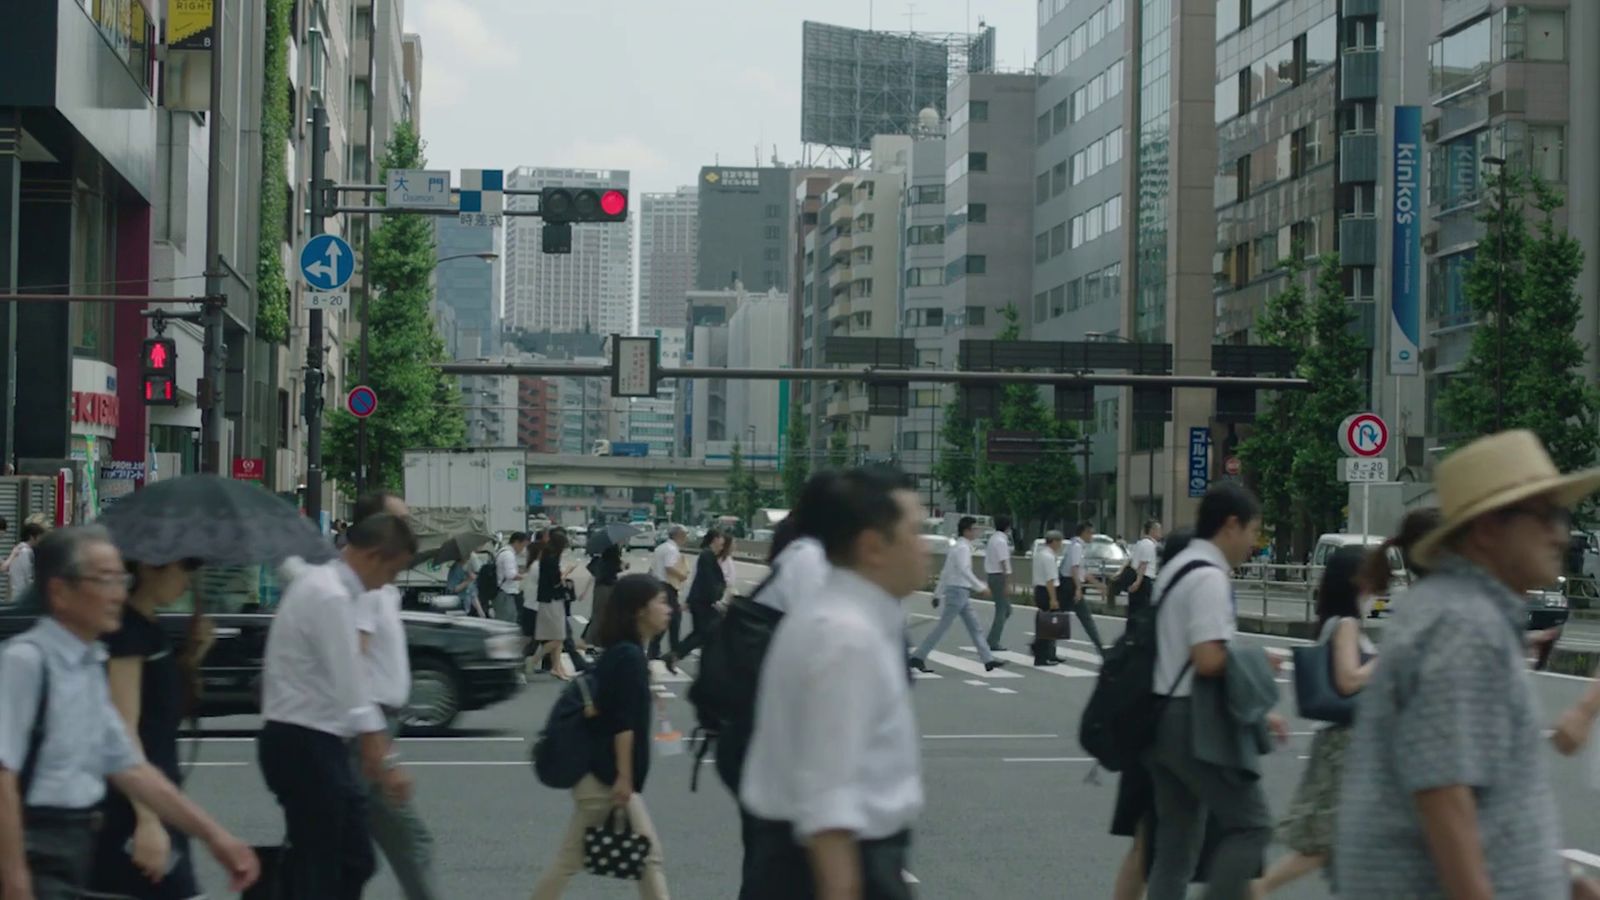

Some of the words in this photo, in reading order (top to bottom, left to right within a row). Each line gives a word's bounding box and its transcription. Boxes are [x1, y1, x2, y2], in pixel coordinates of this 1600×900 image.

[176, 1, 211, 9] RIGHT
[393, 176, 444, 193] 大門
[1396, 143, 1417, 224] kinko's
[460, 213, 503, 227] 時差式
